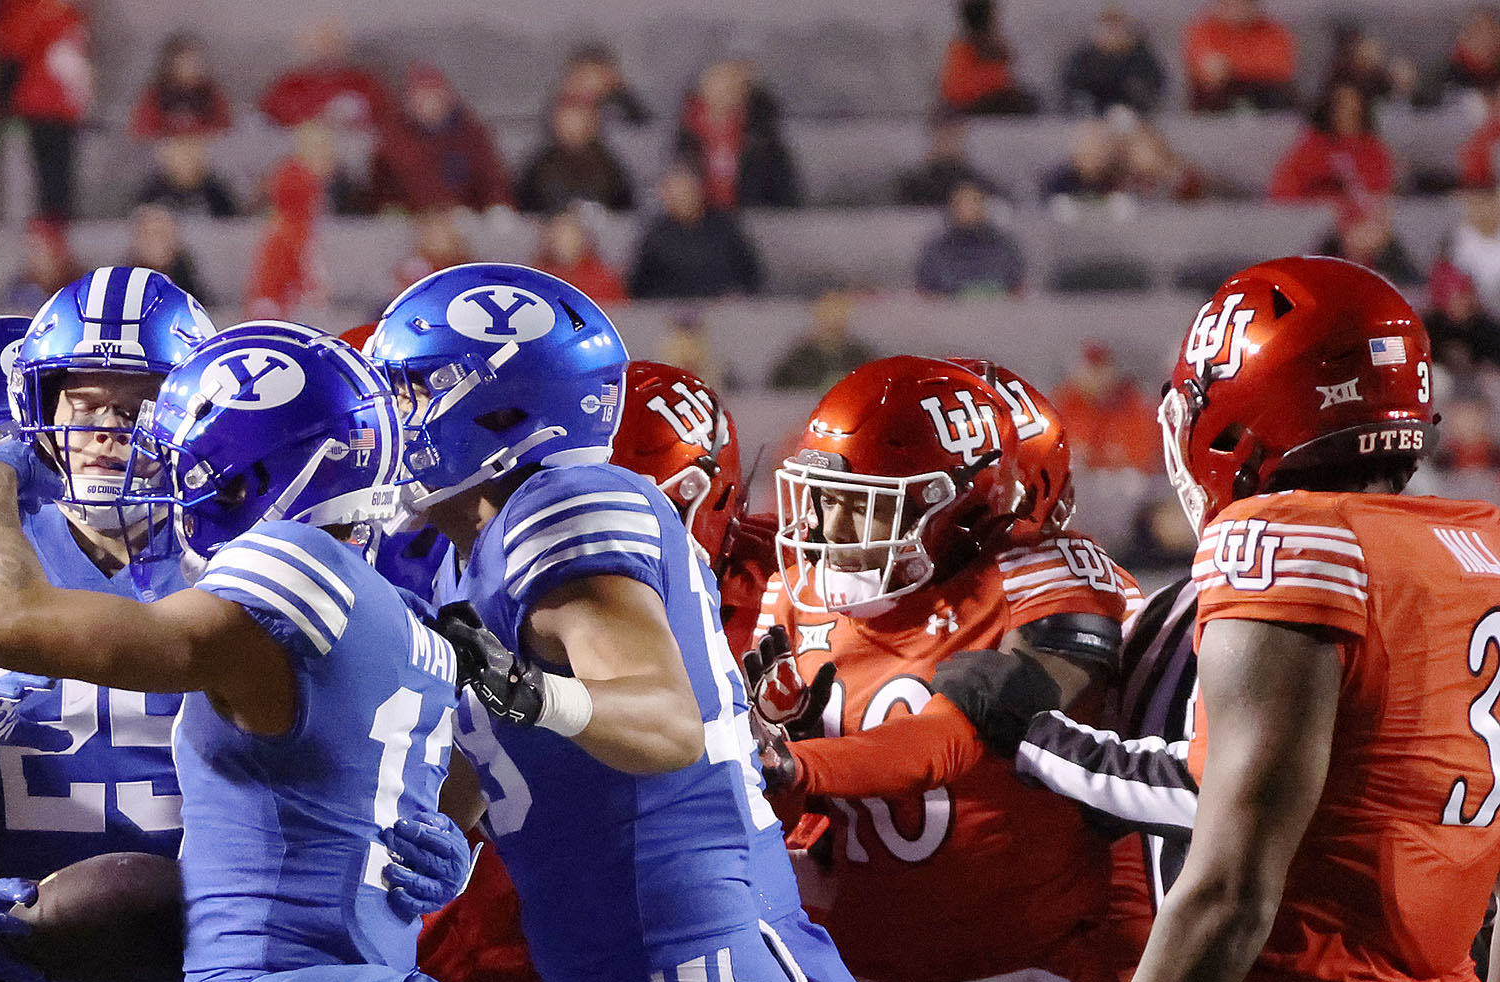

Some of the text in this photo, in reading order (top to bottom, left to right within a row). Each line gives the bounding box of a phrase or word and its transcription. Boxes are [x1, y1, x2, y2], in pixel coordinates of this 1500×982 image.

[463, 289, 538, 335] Y
[92, 341, 122, 354] BYU
[219, 353, 290, 402] Y
[1416, 361, 1431, 404] 3
[601, 405, 614, 422] 18
[1358, 430, 1424, 454] UTES
[355, 449, 371, 467] 17
